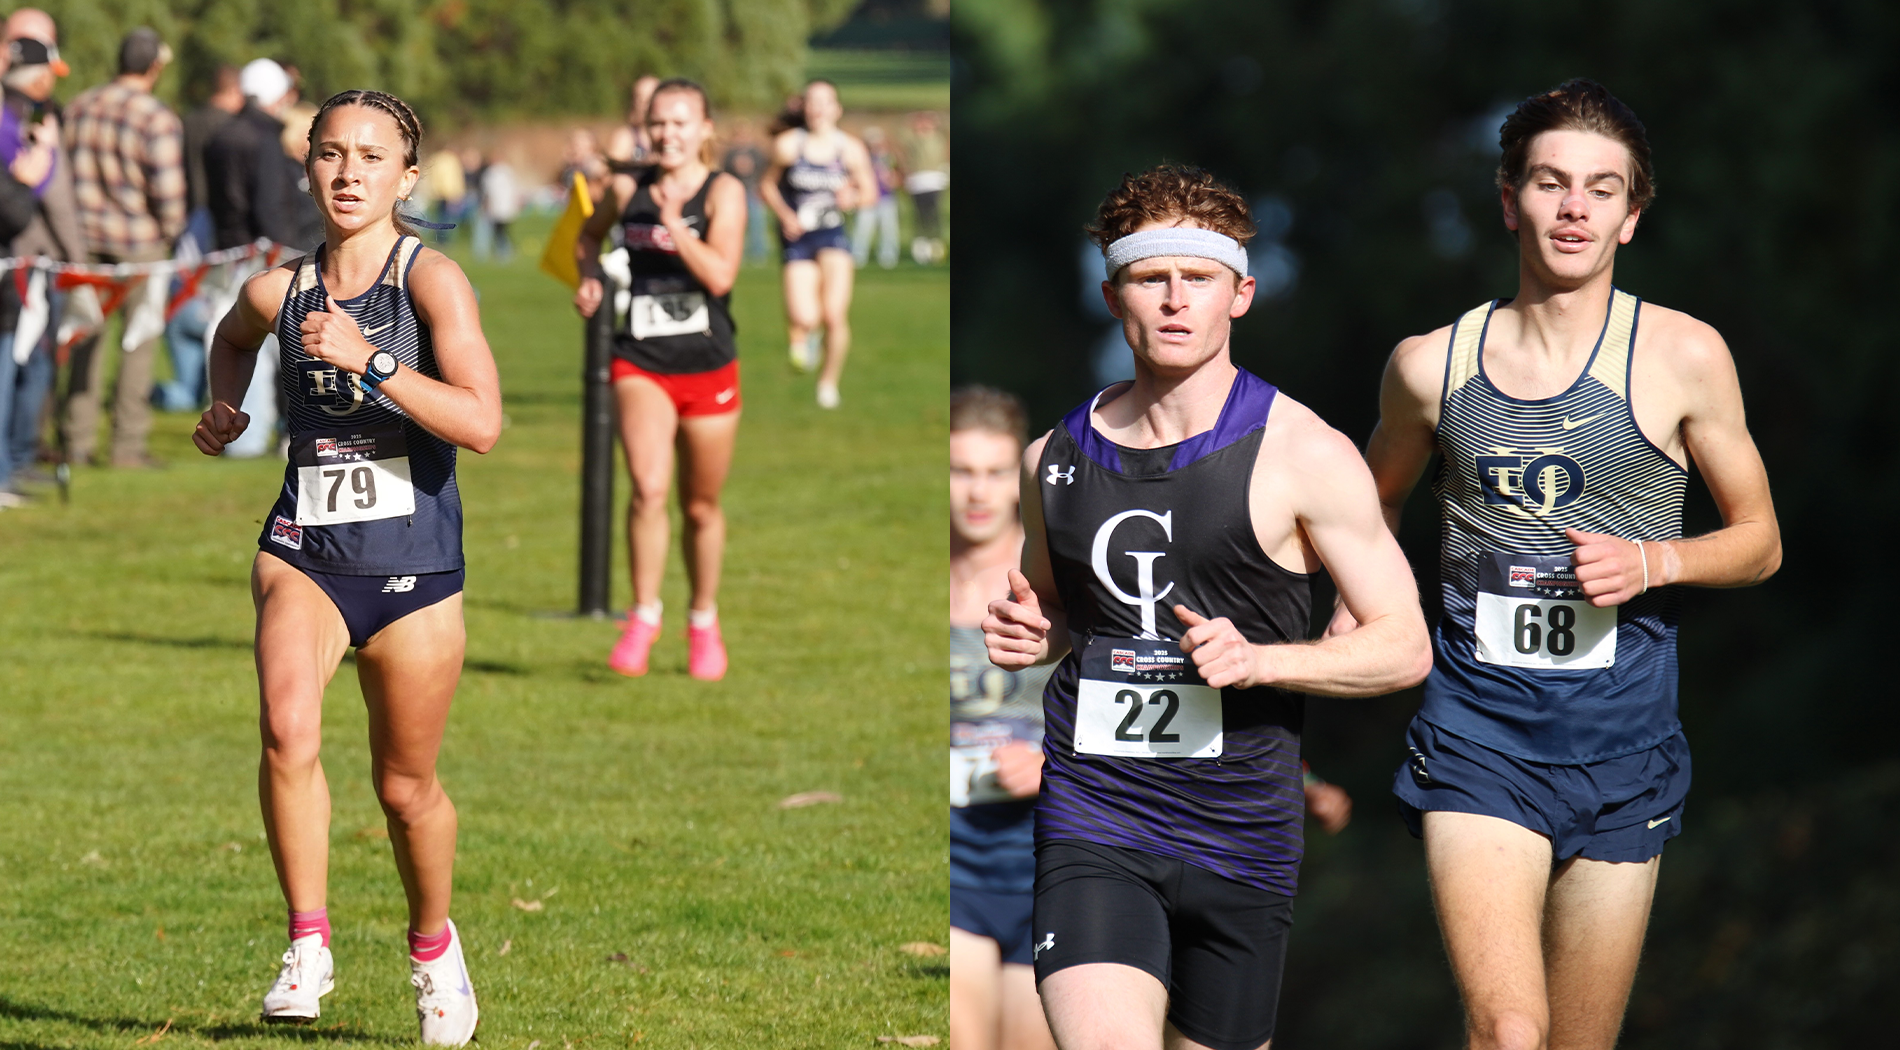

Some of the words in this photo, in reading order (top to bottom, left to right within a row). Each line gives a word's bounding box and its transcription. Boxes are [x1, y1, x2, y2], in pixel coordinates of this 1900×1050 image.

[323, 466, 377, 512] 79
[275, 525, 300, 542] CCC
[1514, 603, 1576, 656] 68
[1114, 689, 1180, 743] 22
